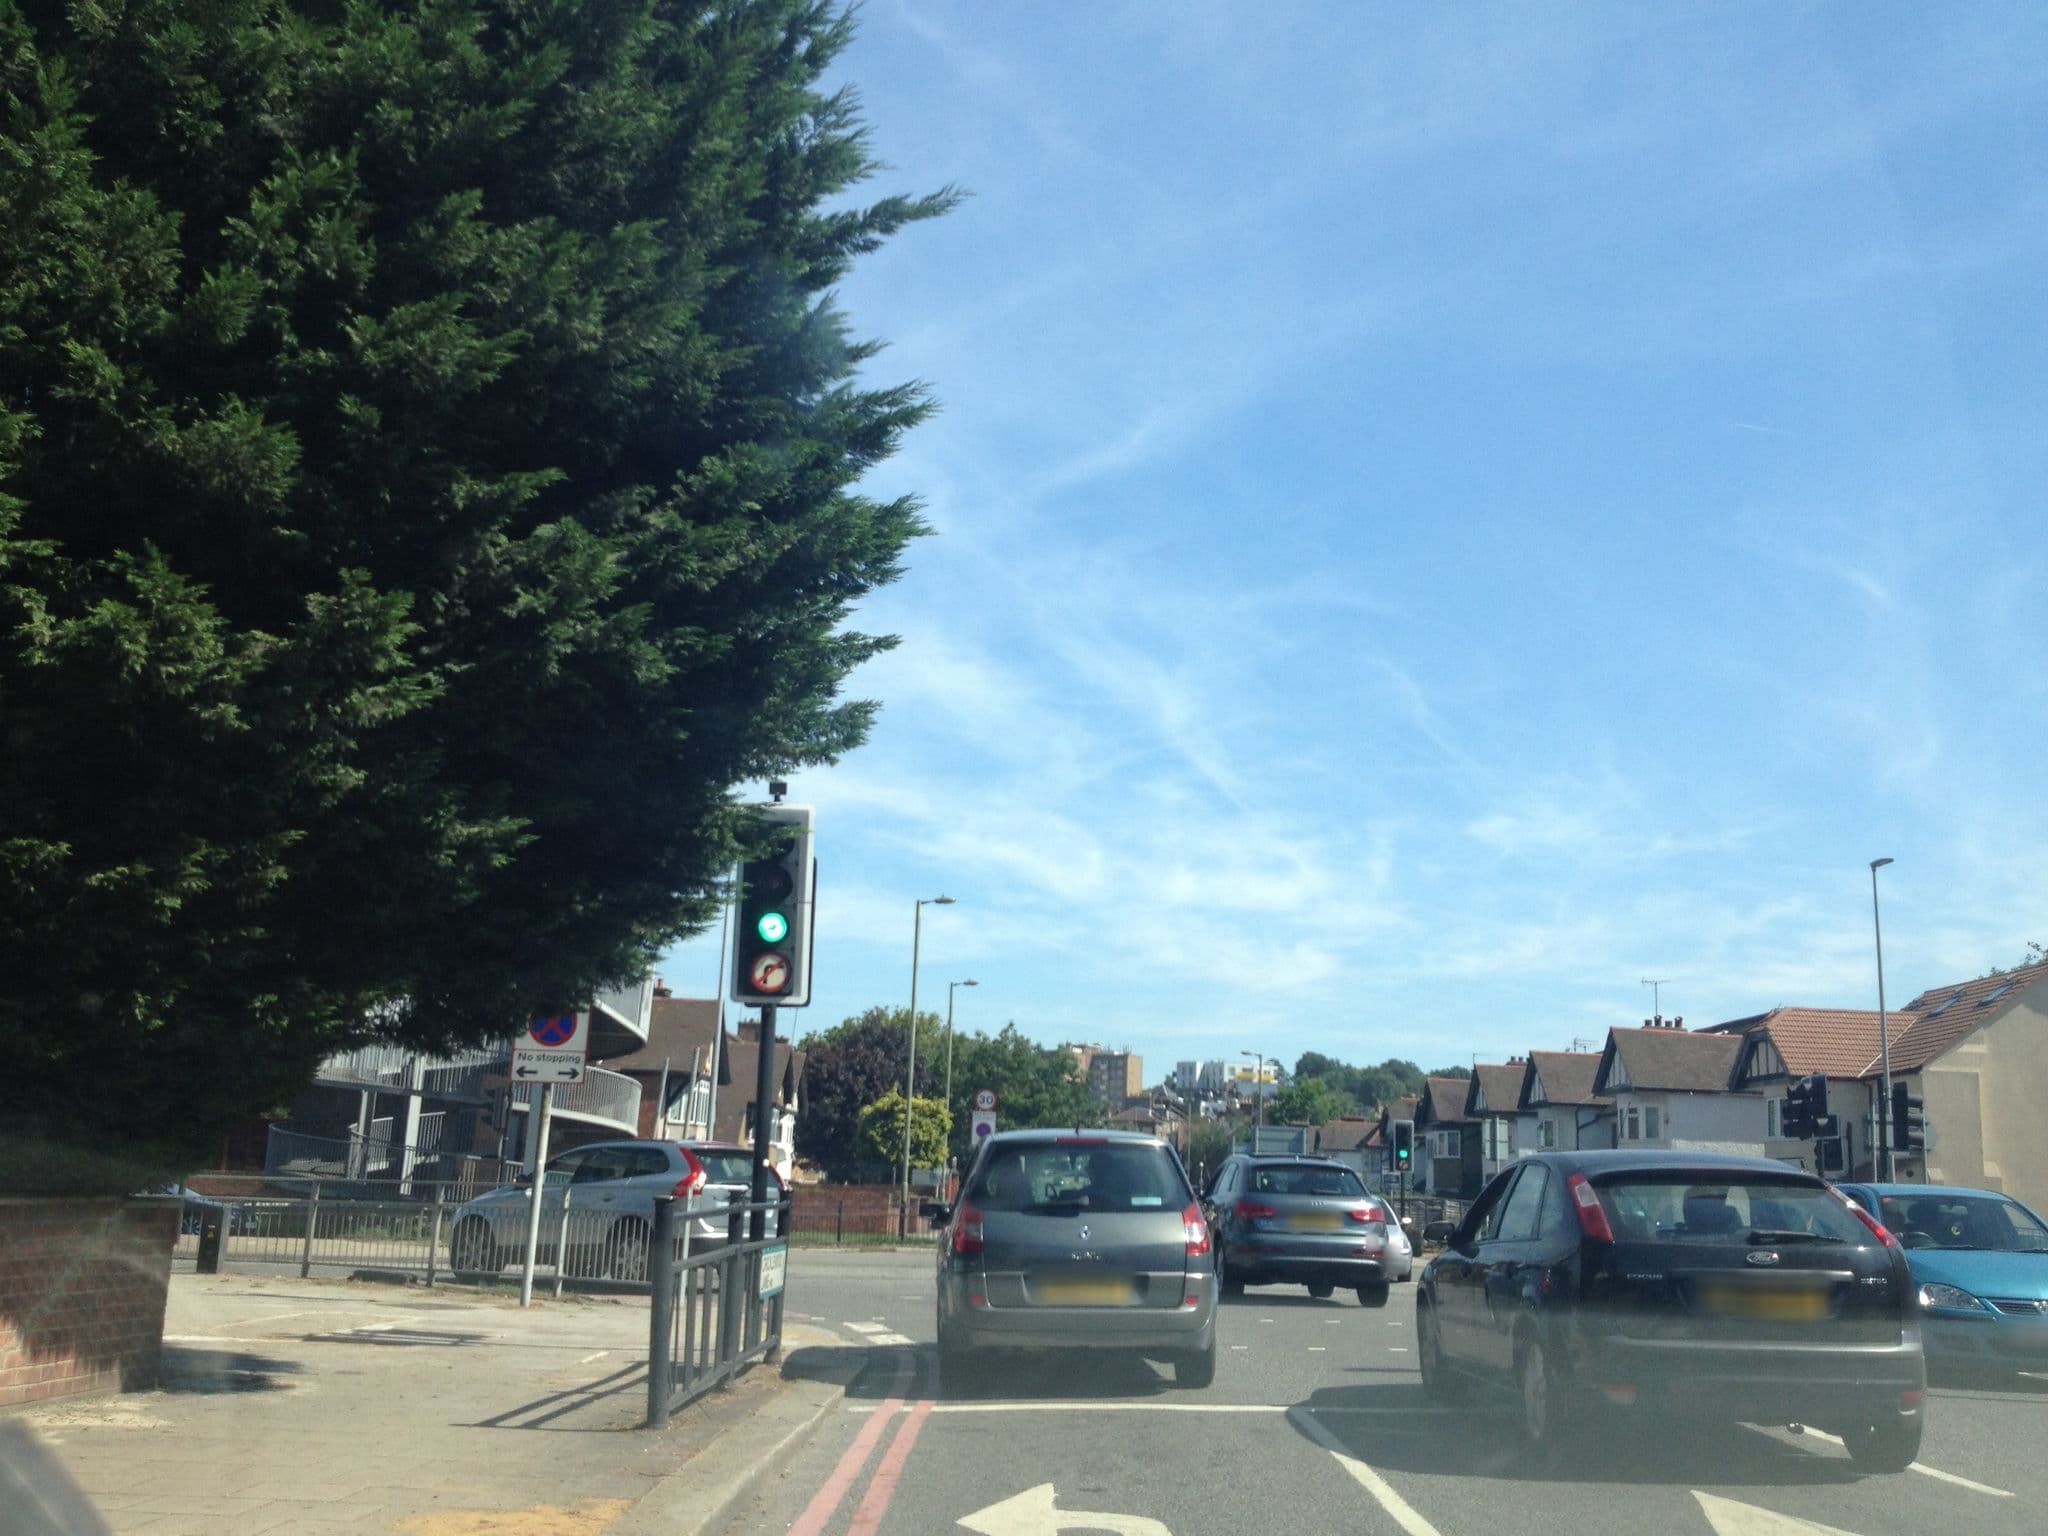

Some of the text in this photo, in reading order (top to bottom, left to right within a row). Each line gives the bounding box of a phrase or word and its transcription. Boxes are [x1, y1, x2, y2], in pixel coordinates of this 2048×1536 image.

[518, 1052, 581, 1064] No stopping
[980, 1095, 993, 1104] 30
